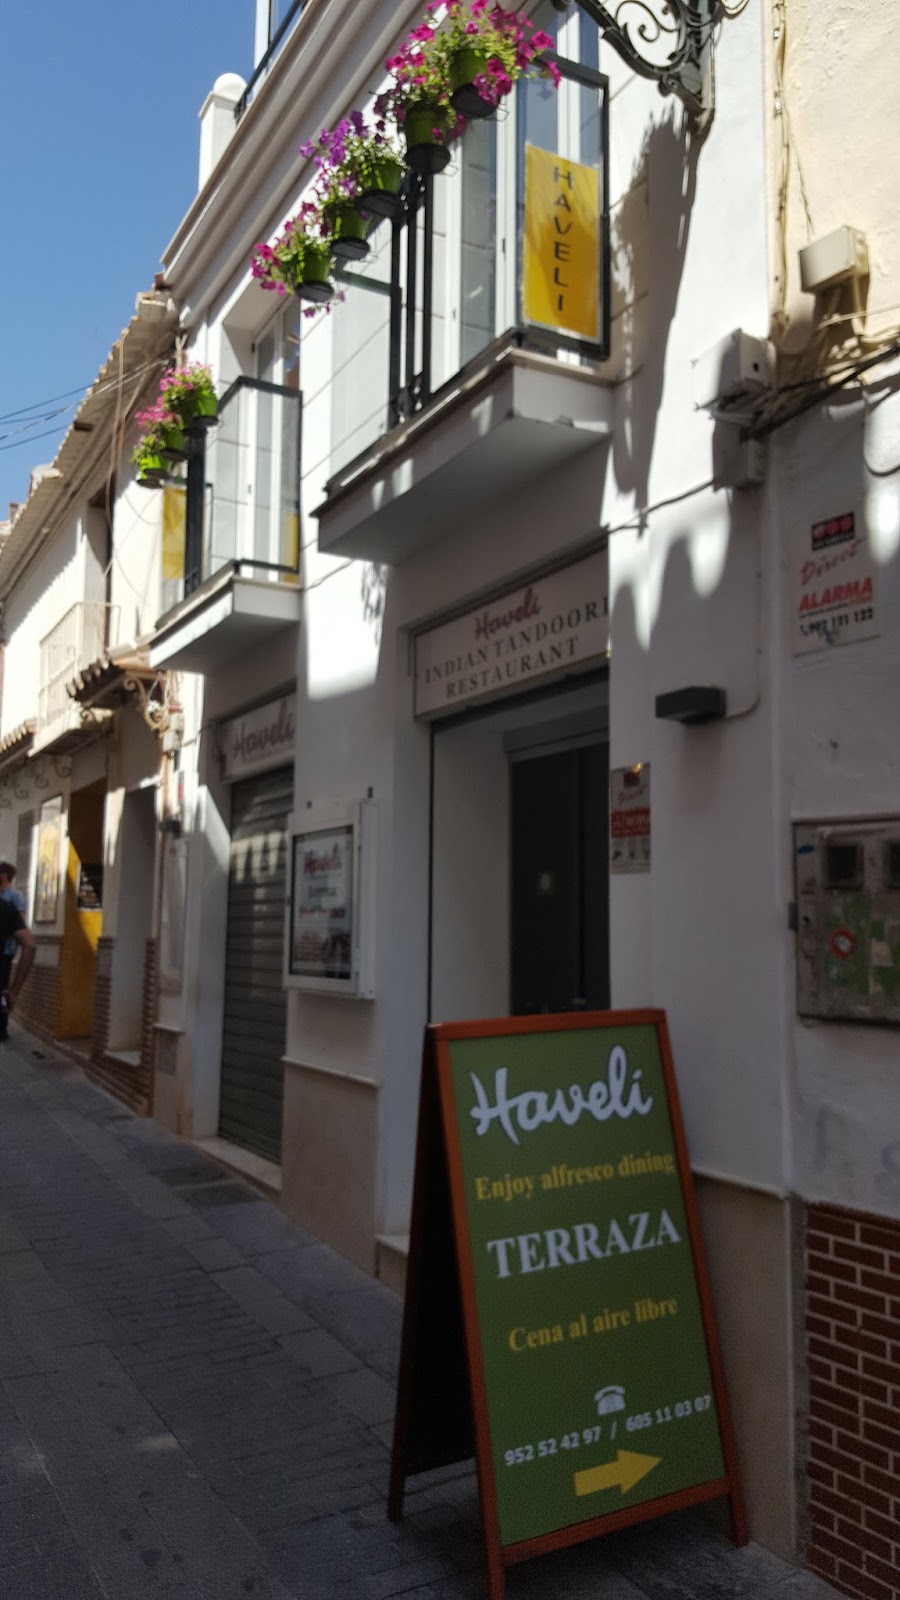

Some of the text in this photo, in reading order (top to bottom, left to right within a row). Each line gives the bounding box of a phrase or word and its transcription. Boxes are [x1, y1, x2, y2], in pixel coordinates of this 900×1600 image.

[553, 166, 572, 311] HAVELI
[474, 587, 542, 640] Haveli
[799, 577, 873, 613] ALARMA
[425, 596, 609, 684] INDIAN TANDOORI
[446, 636, 579, 699] RESTAURANT
[233, 698, 296, 760] Haveli
[469, 1045, 653, 1145] Haveli
[474, 1152, 676, 1201] Enjoy alfresco dining
[486, 1209, 681, 1279] TERRAZA
[507, 1298, 679, 1352] Cena al aire libre
[504, 1444, 537, 1466] 952
[537, 1438, 558, 1458] 52
[560, 1431, 581, 1450] 42
[582, 1425, 602, 1445] 97
[655, 1406, 672, 1424] 11
